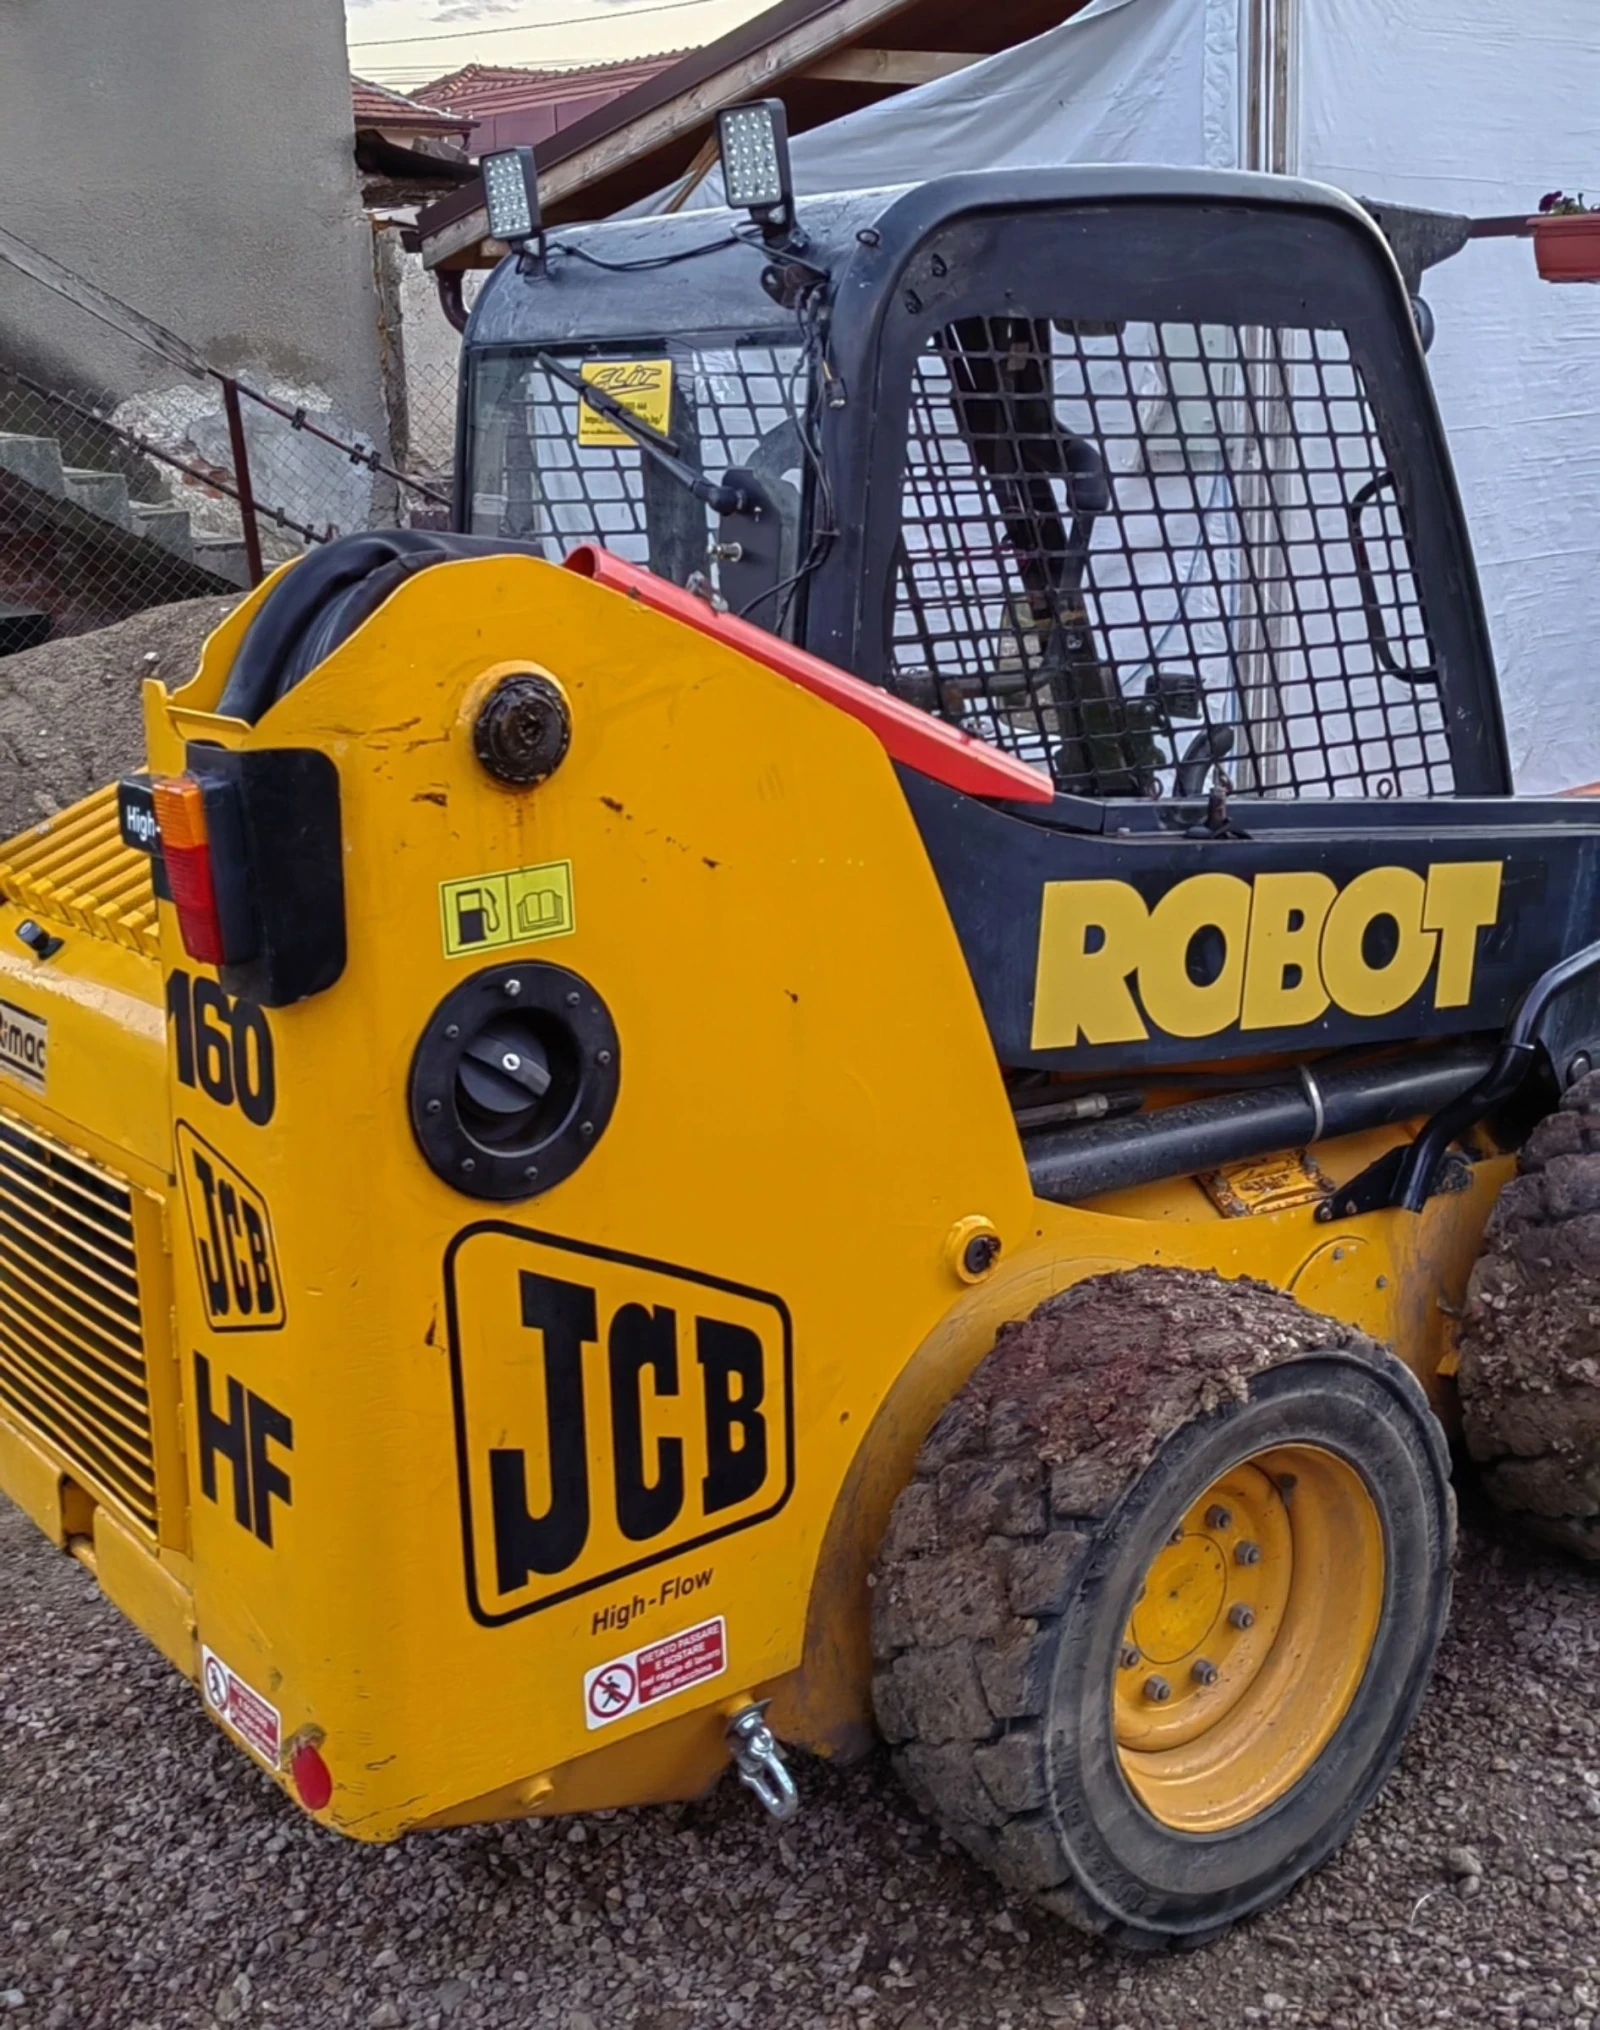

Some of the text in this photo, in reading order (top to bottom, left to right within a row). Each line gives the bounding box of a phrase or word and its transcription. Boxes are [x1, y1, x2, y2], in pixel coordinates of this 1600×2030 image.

[1030, 861, 1503, 1050] ROBOT
[167, 967, 276, 1126] 160
[192, 1148, 275, 1316] JCB
[193, 1349, 294, 1550] HF
[489, 1269, 767, 1596] JCB
[591, 1567, 714, 1636] High-Flow
[640, 1624, 720, 1665] VIETATO PASSARE
[655, 1641, 705, 1671] E SOSTARE
